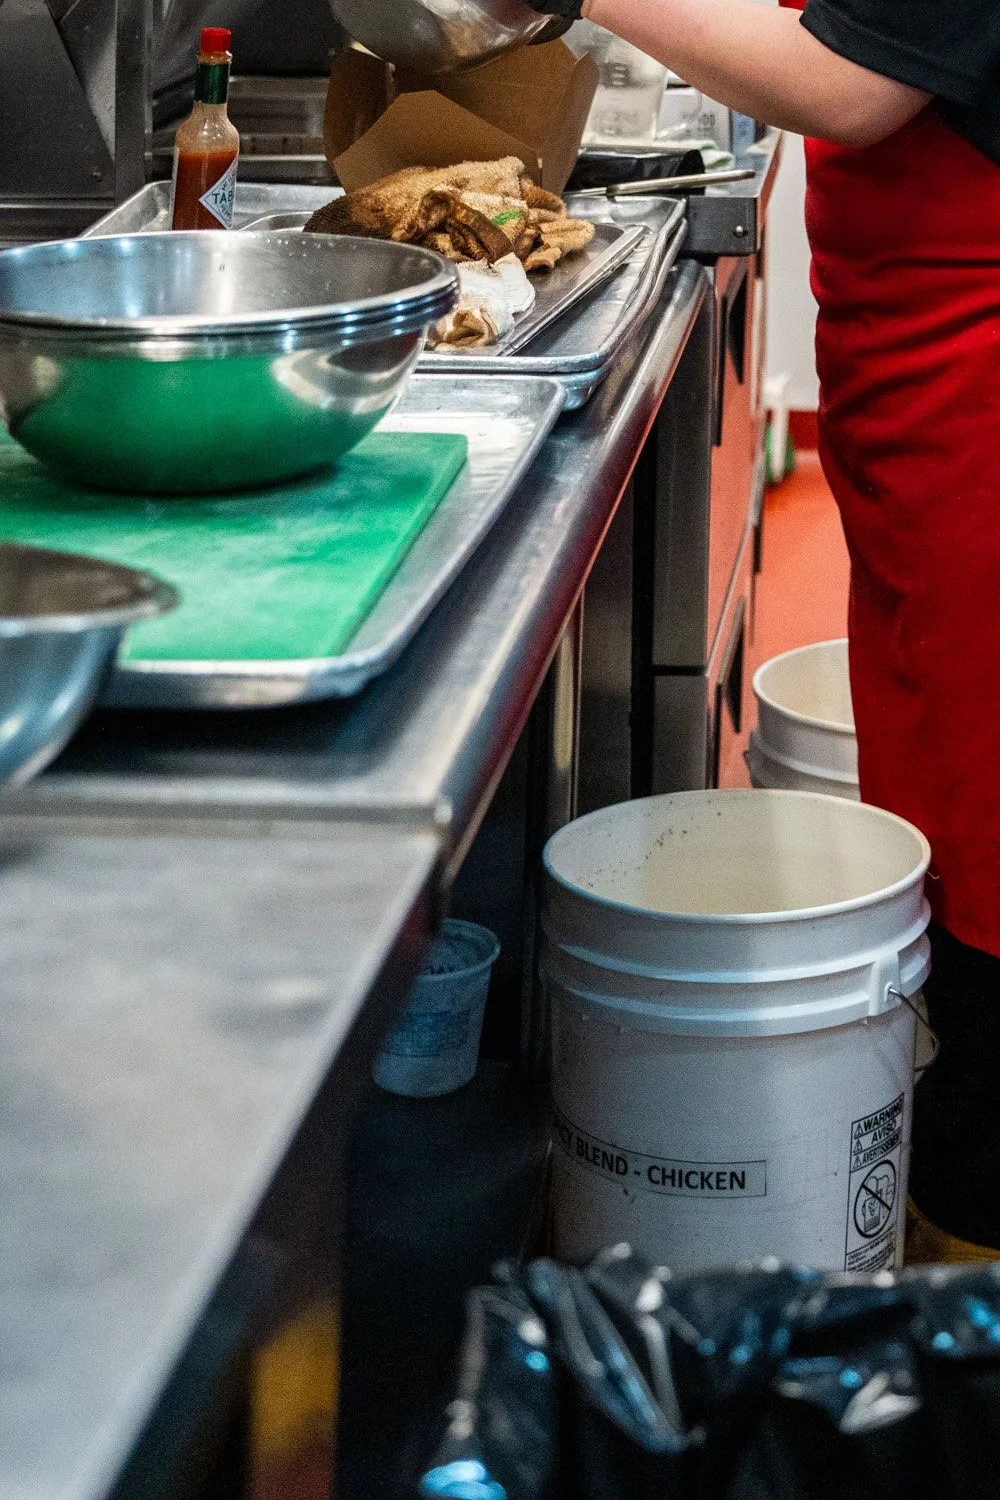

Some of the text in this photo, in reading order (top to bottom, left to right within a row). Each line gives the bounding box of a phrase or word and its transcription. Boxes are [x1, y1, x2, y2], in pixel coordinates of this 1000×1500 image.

[863, 1098, 903, 1132] WARNING
[871, 1118, 897, 1145] AVISO
[576, 1137, 628, 1177] BLEND
[646, 1165, 746, 1191] CHICKEN
